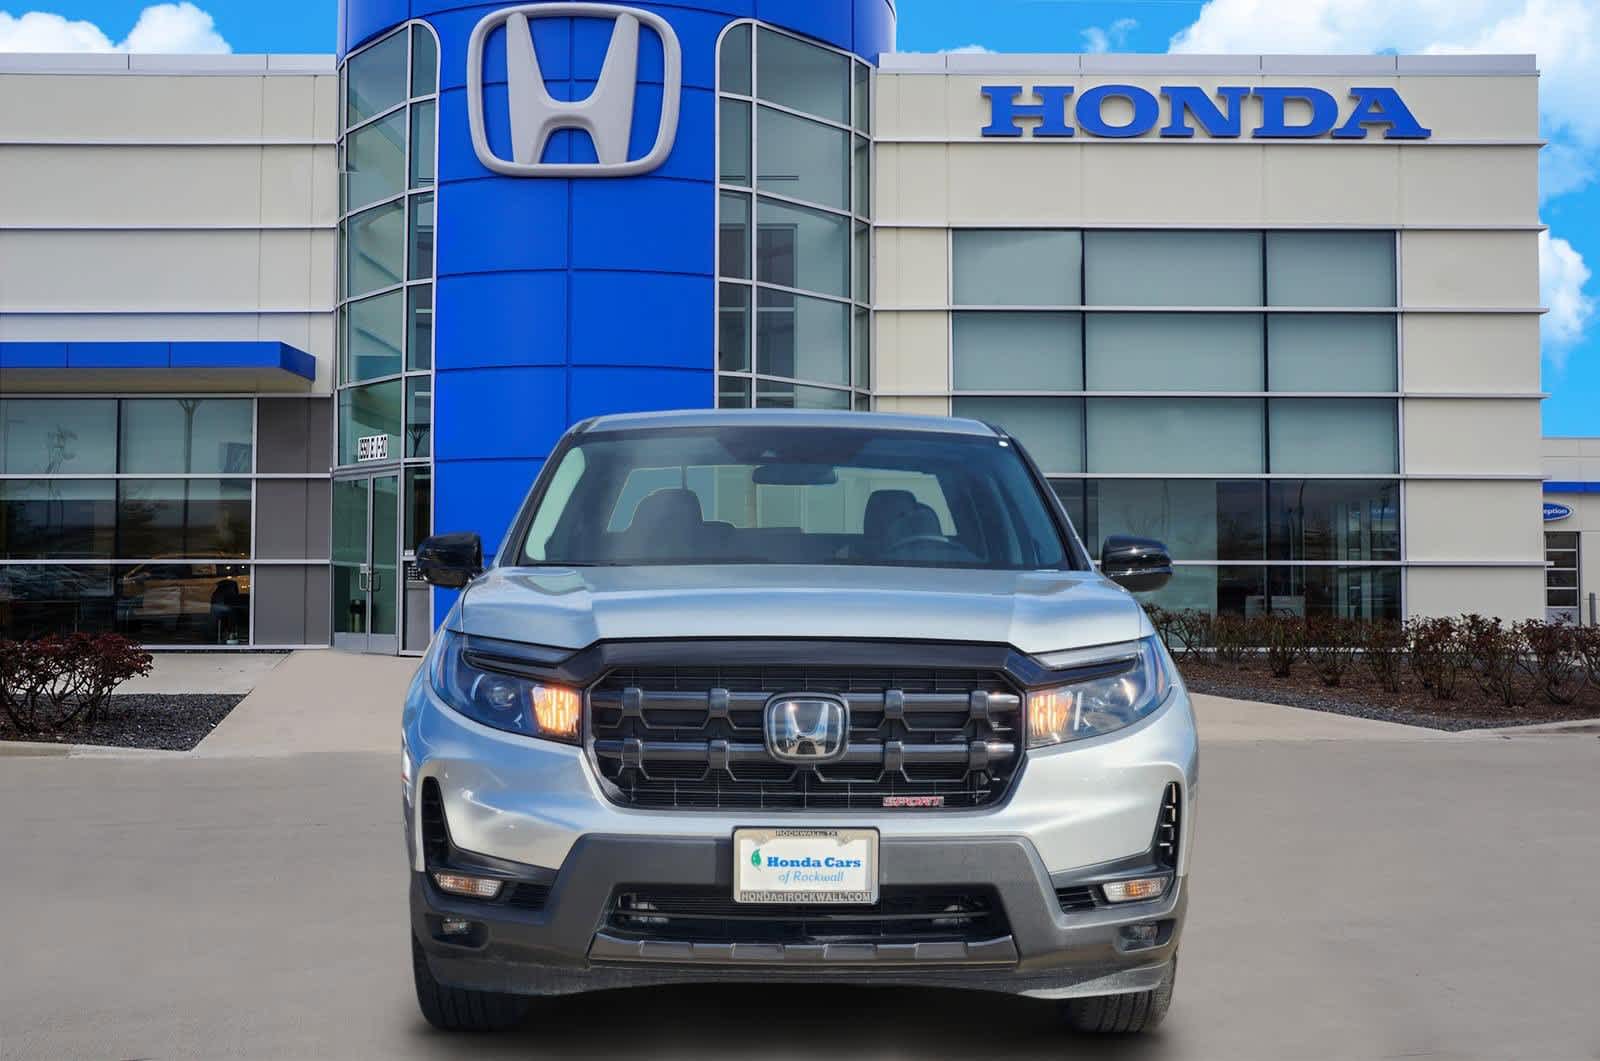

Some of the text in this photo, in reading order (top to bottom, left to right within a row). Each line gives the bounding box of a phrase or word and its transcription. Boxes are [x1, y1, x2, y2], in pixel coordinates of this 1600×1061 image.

[981, 84, 1432, 140] HONDA
[882, 796, 943, 807] SPORT
[767, 856, 861, 868] Honda Cars
[778, 870, 845, 884] of Rockwall
